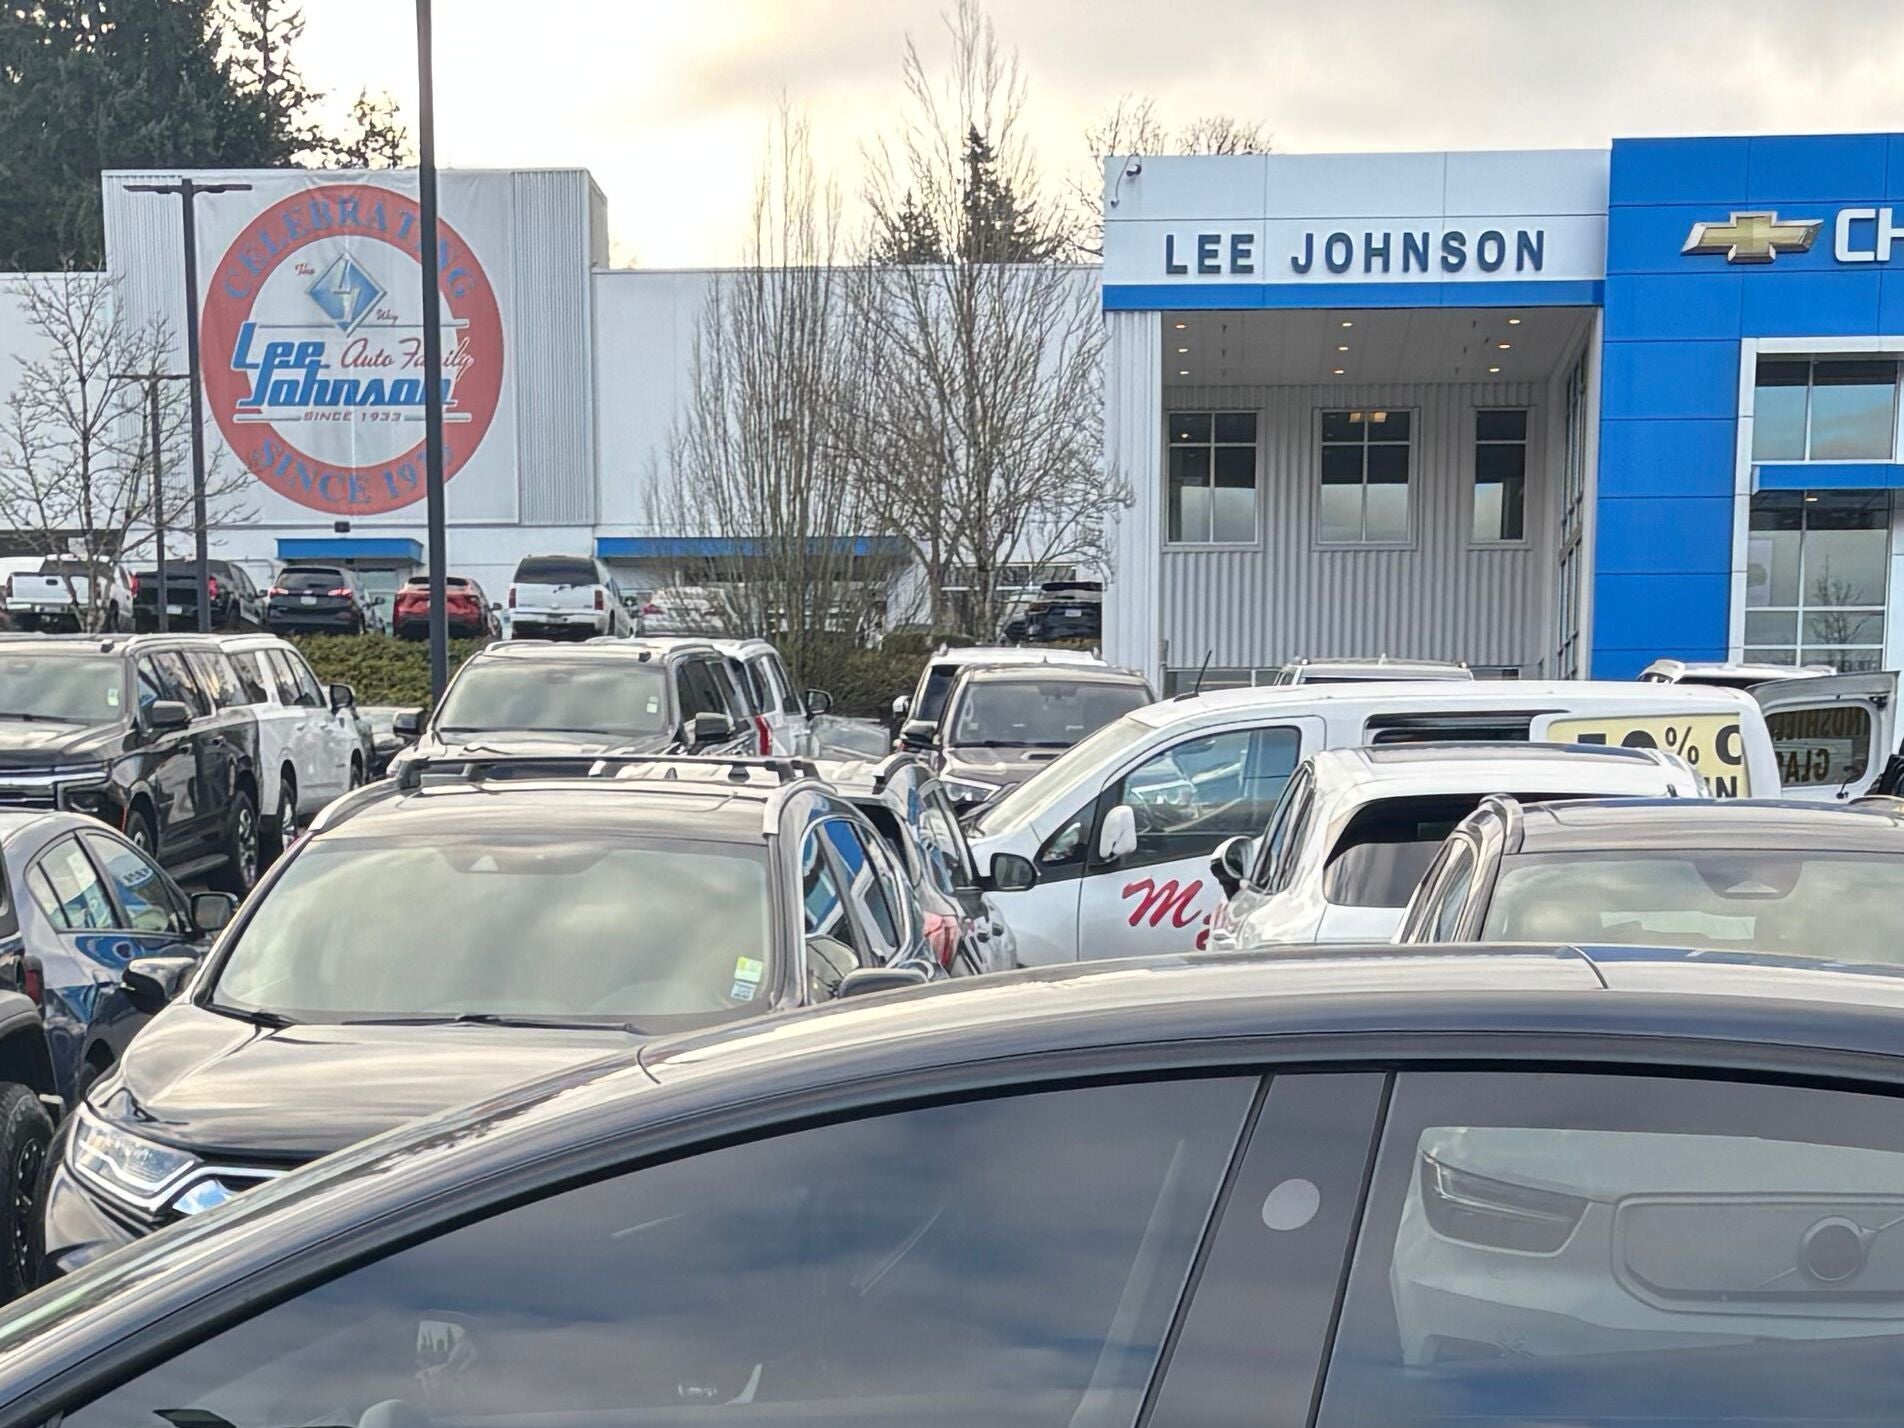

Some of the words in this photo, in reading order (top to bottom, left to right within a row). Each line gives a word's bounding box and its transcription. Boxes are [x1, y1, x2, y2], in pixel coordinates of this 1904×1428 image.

[222, 197, 478, 300] CELEBRATNG
[1165, 233, 1255, 275] LEE
[1291, 230, 1545, 274] JOHNSON
[232, 322, 330, 370] Lee
[340, 338, 395, 367] Auto
[398, 337, 475, 381] Faily
[302, 412, 352, 422] SINCE
[361, 412, 401, 422] 1933
[255, 439, 372, 504] SINCE
[385, 444, 454, 498] 19
